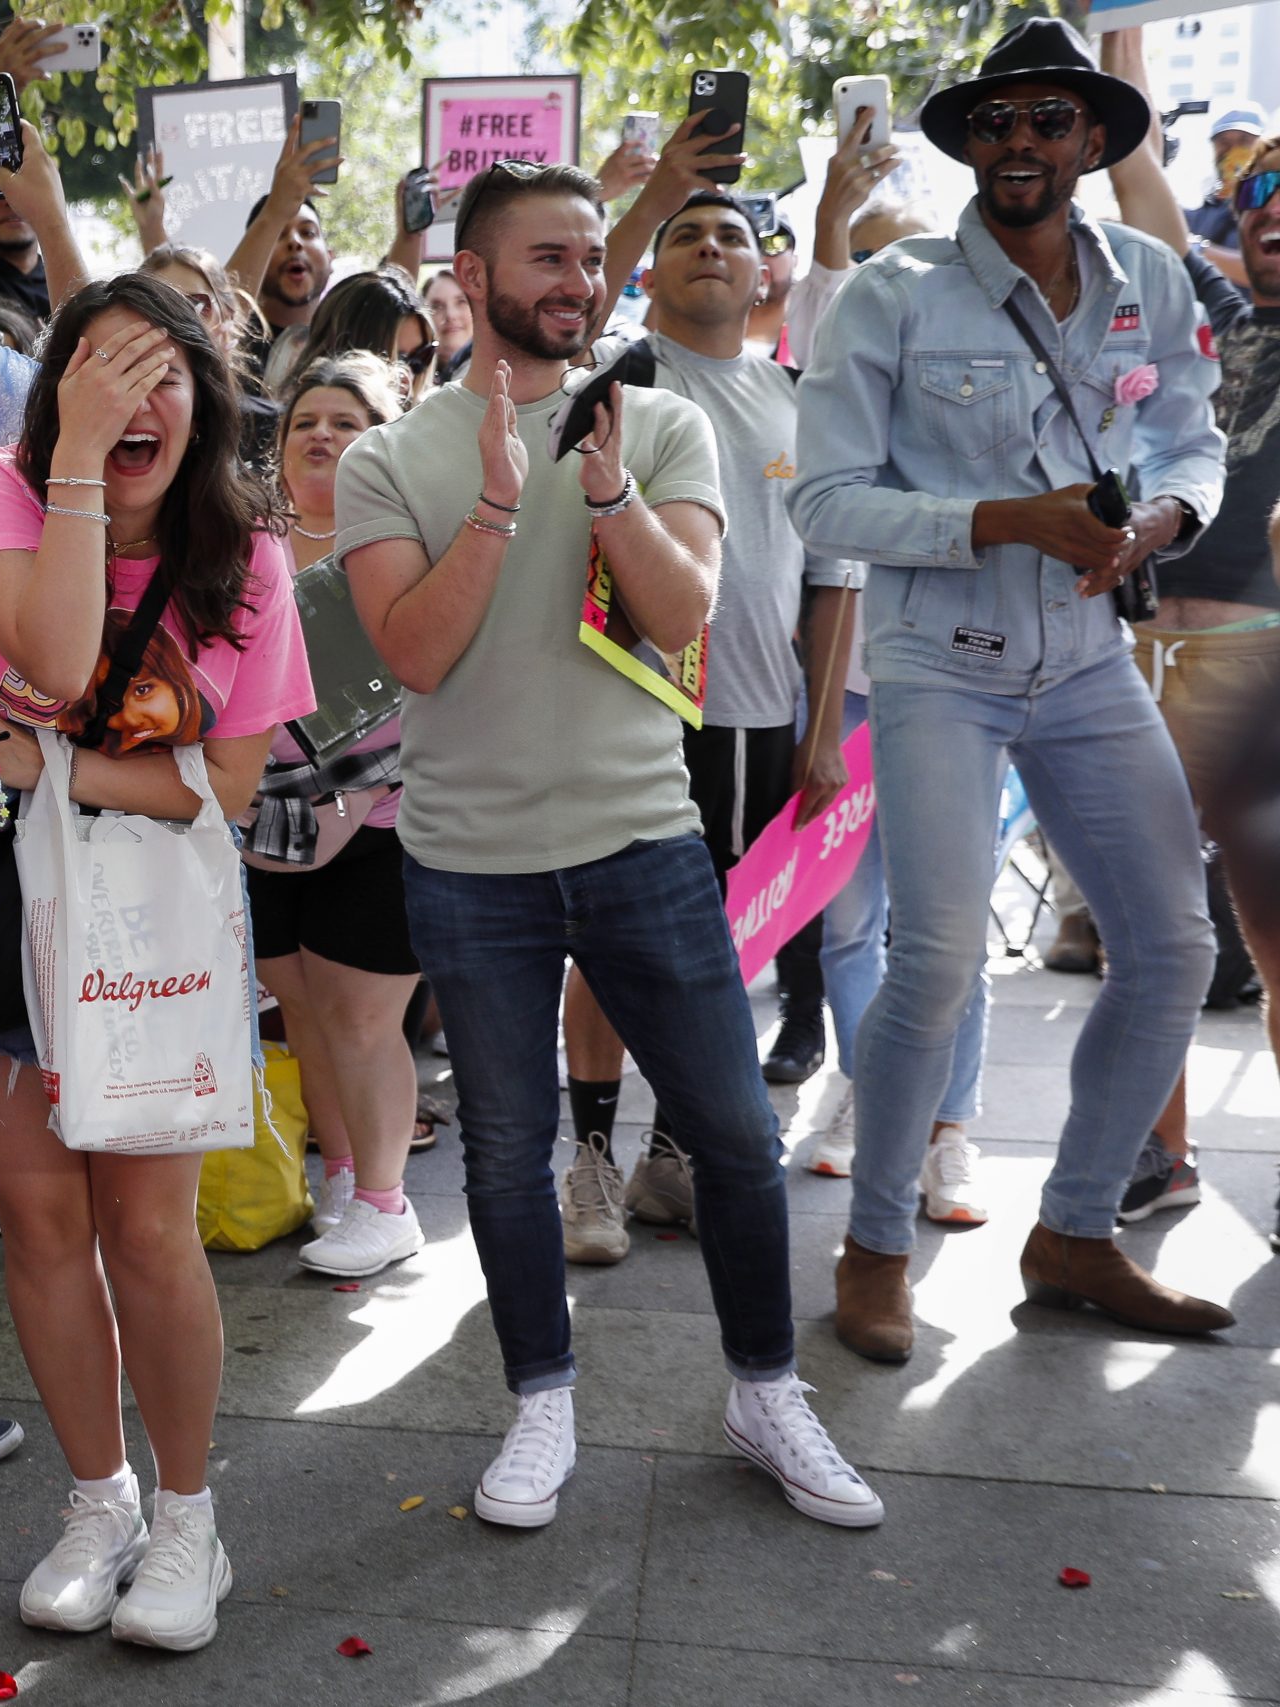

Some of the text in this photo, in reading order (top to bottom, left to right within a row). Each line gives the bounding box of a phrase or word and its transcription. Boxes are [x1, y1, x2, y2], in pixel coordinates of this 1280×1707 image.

[460, 114, 533, 138] #FREE
[958, 629, 1003, 643] STRONGER
[968, 637, 991, 647] THAN
[953, 643, 1001, 657] YESTERDAY
